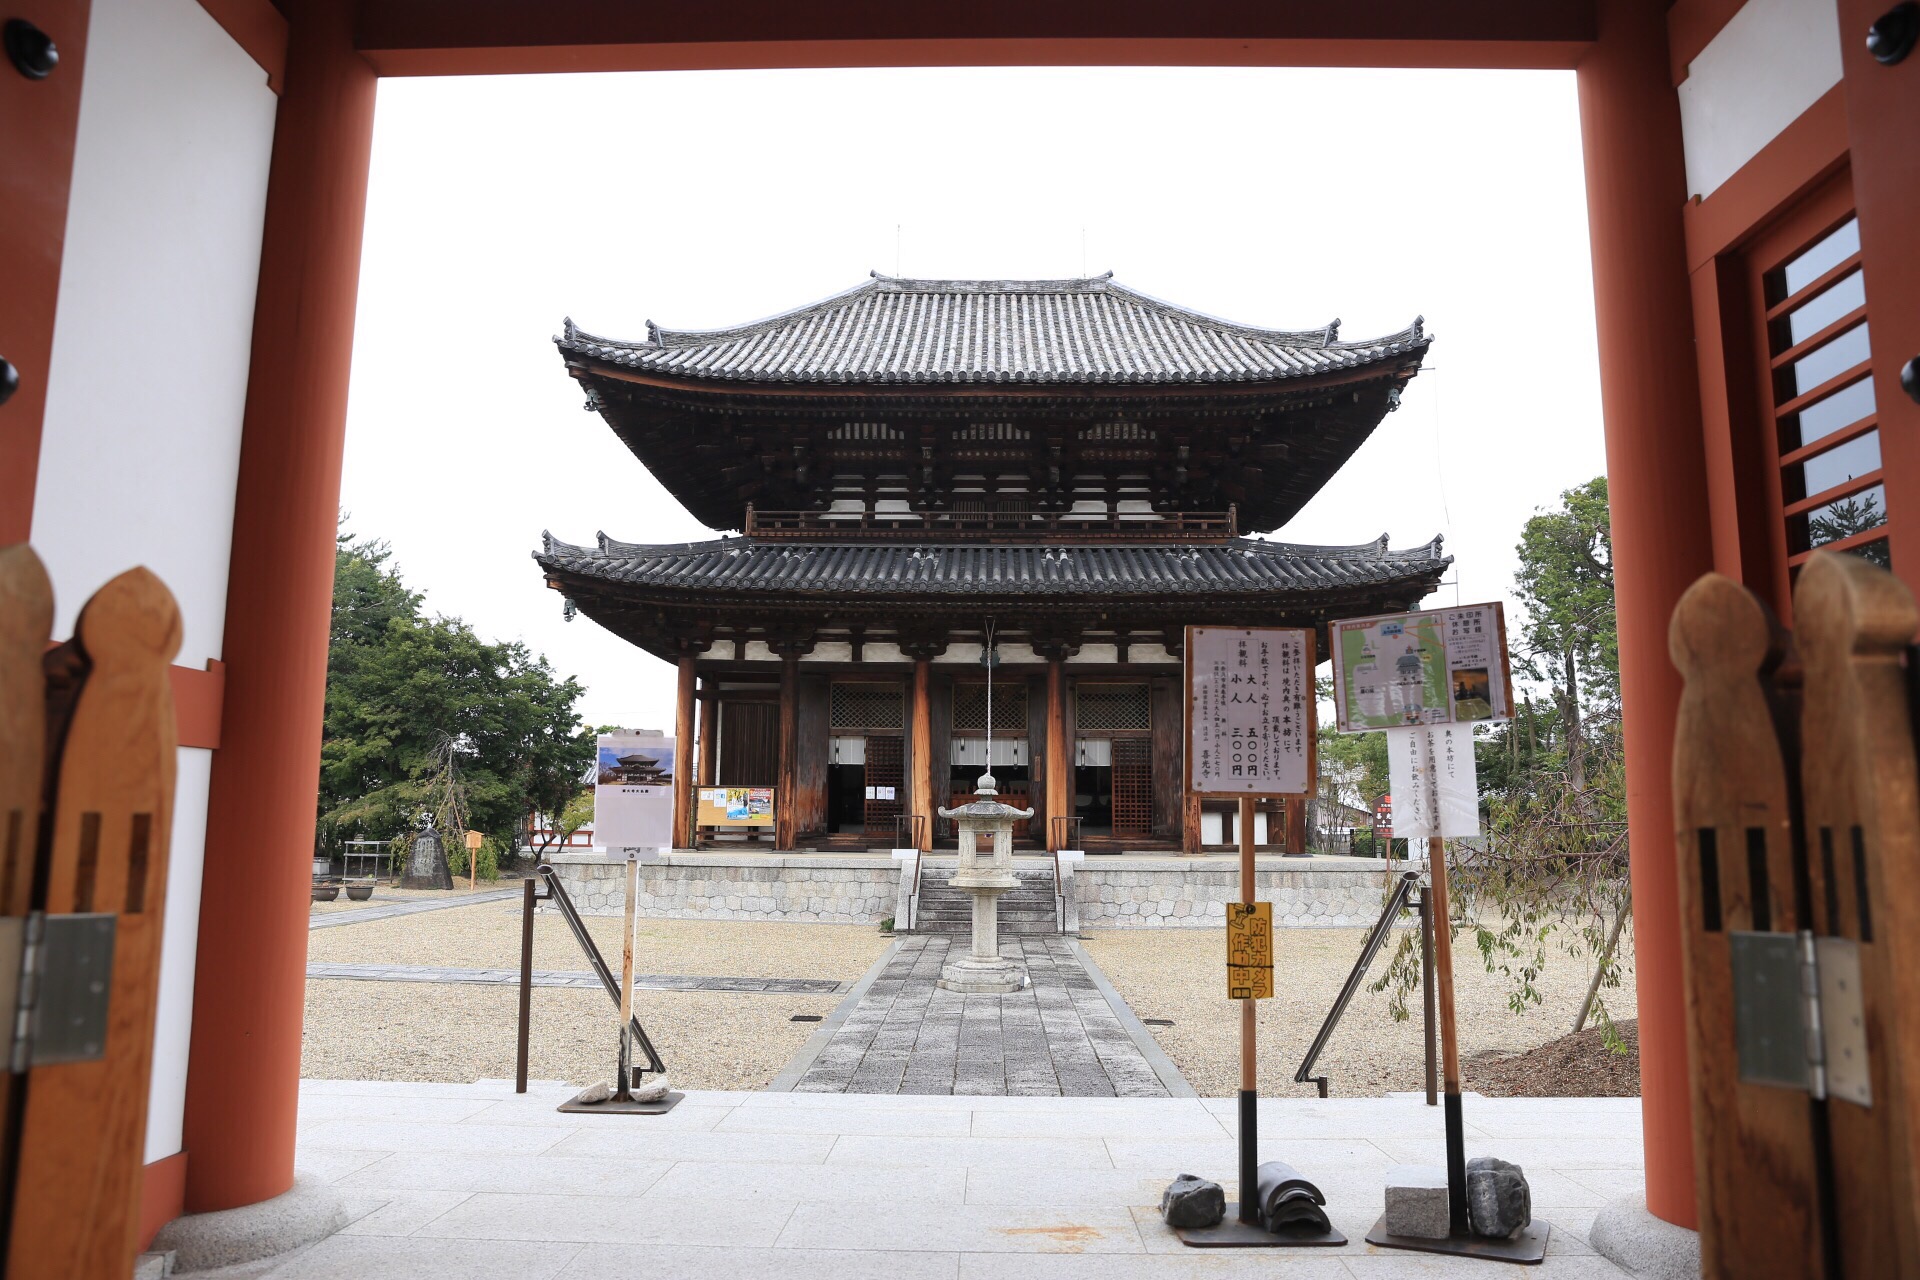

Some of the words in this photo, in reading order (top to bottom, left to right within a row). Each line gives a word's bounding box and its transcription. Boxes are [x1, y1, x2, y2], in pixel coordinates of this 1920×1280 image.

[1449, 611, 1482, 620] ご朱印所
[1452, 619, 1480, 628] 休憩所
[1452, 626, 1482, 635] お写経
[1238, 640, 1247, 668] 拝観料
[1230, 673, 1242, 704] 小人
[1246, 674, 1258, 704] 大人
[1260, 641, 1271, 780] お手数ですが、必ずお立ち寄りください。
[1272, 716, 1280, 780] 頂戴しております。
[1445, 729, 1455, 778] 奥の本坊にて
[1201, 749, 1211, 778] 喜光寺
[1232, 933, 1250, 985] 作動中
[1249, 917, 1267, 999] 防犯カメラ
